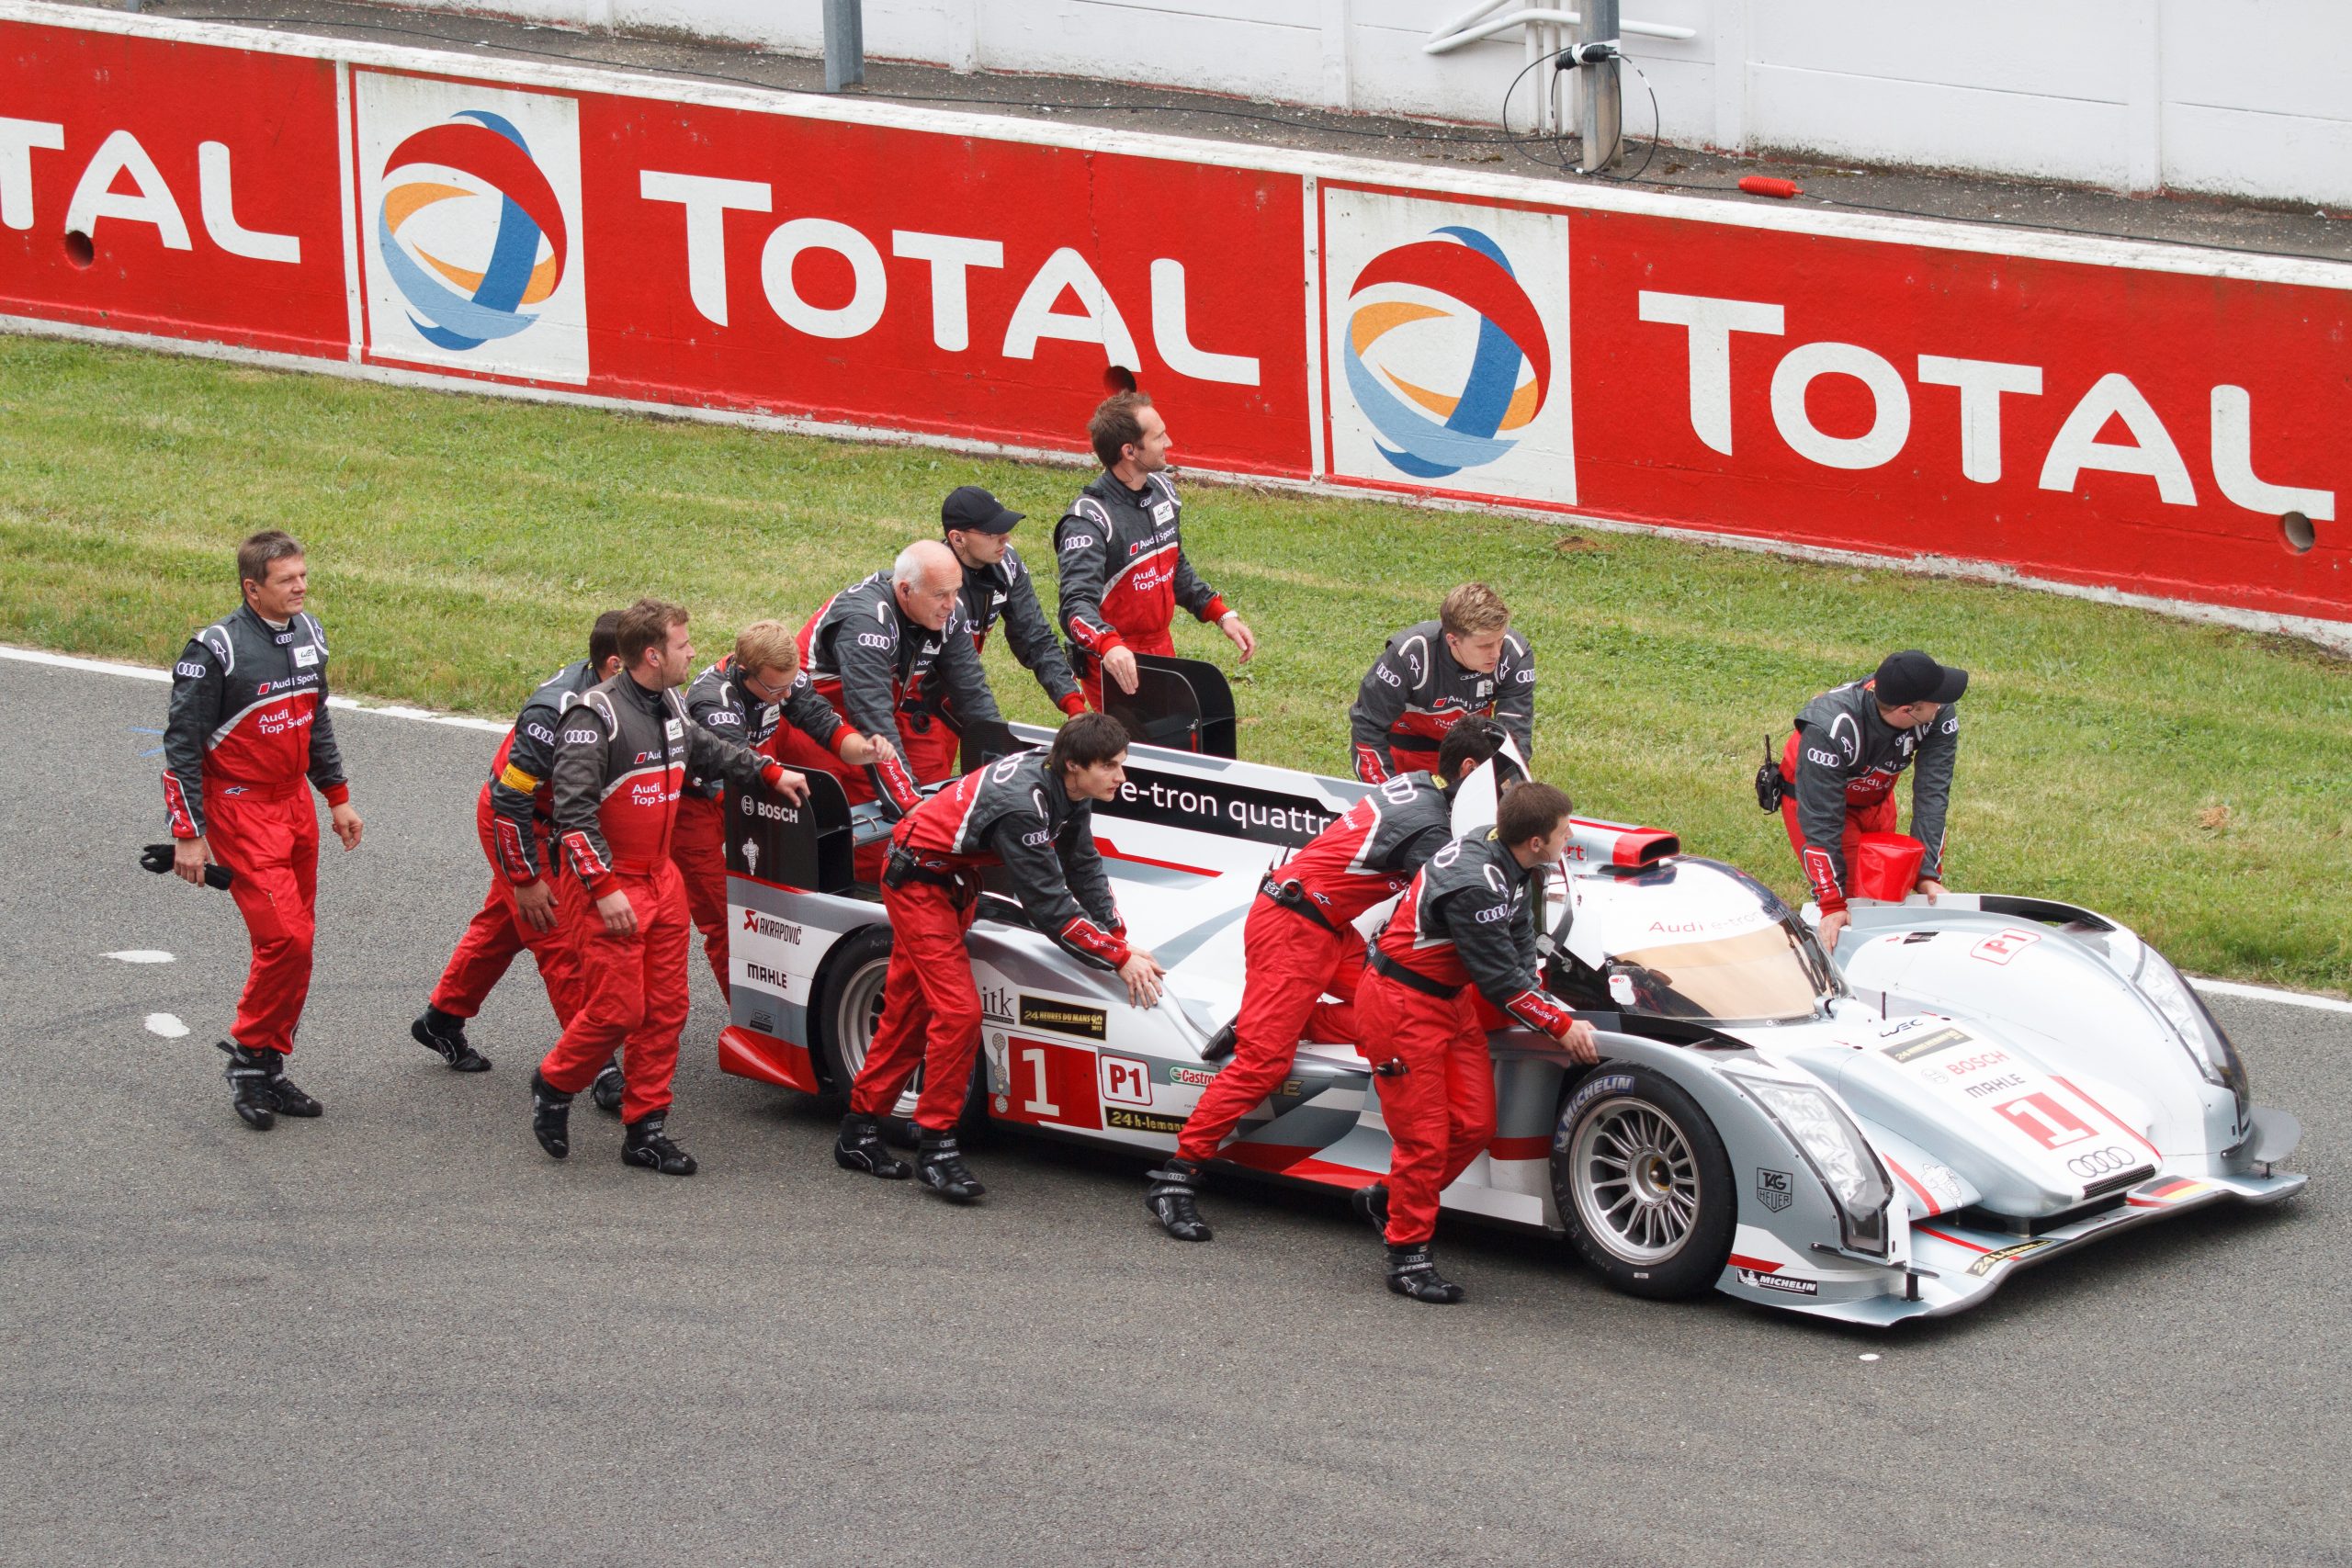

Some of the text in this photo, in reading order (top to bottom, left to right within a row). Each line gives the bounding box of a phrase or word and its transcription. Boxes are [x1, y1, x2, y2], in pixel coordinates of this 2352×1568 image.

[639, 170, 1261, 387] TOTAL
[1639, 289, 2335, 521] TOTAL
[1139, 527, 1176, 549] Audi Sport
[1132, 567, 1156, 582] Audi
[1133, 581, 1155, 591] Top
[272, 673, 318, 690] Audi Sport
[258, 709, 288, 724] Audi
[259, 724, 284, 734] Top
[632, 783, 661, 794] Audi
[887, 766, 909, 801] Audi Sport
[632, 795, 655, 807] Top
[1121, 781, 1336, 836] e-tron quattr
[757, 802, 798, 824] BOSCH
[1648, 921, 1703, 932] Audi
[1983, 934, 2028, 955] P1
[747, 963, 787, 989] MAHLE
[981, 987, 1014, 1017] itk
[1023, 1010, 1039, 1021] 24
[1039, 1011, 1062, 1021] HEURES
[1062, 1013, 1072, 1021] DU
[1072, 1014, 1091, 1023] MANS
[1879, 1020, 1923, 1037] WEC
[1946, 1050, 2010, 1075] BOSCH
[1022, 1048, 1059, 1117] 1
[1109, 1064, 1142, 1098] P1
[1182, 1069, 1218, 1084] Castro
[1964, 1073, 2027, 1099] MAHLE
[1562, 1077, 1632, 1128] MICHELIN
[2005, 1099, 2090, 1146] 1
[1762, 1172, 1787, 1190] TAG
[1758, 1190, 1790, 1210] HEUER
[1759, 1275, 1815, 1292] MICHELIN
